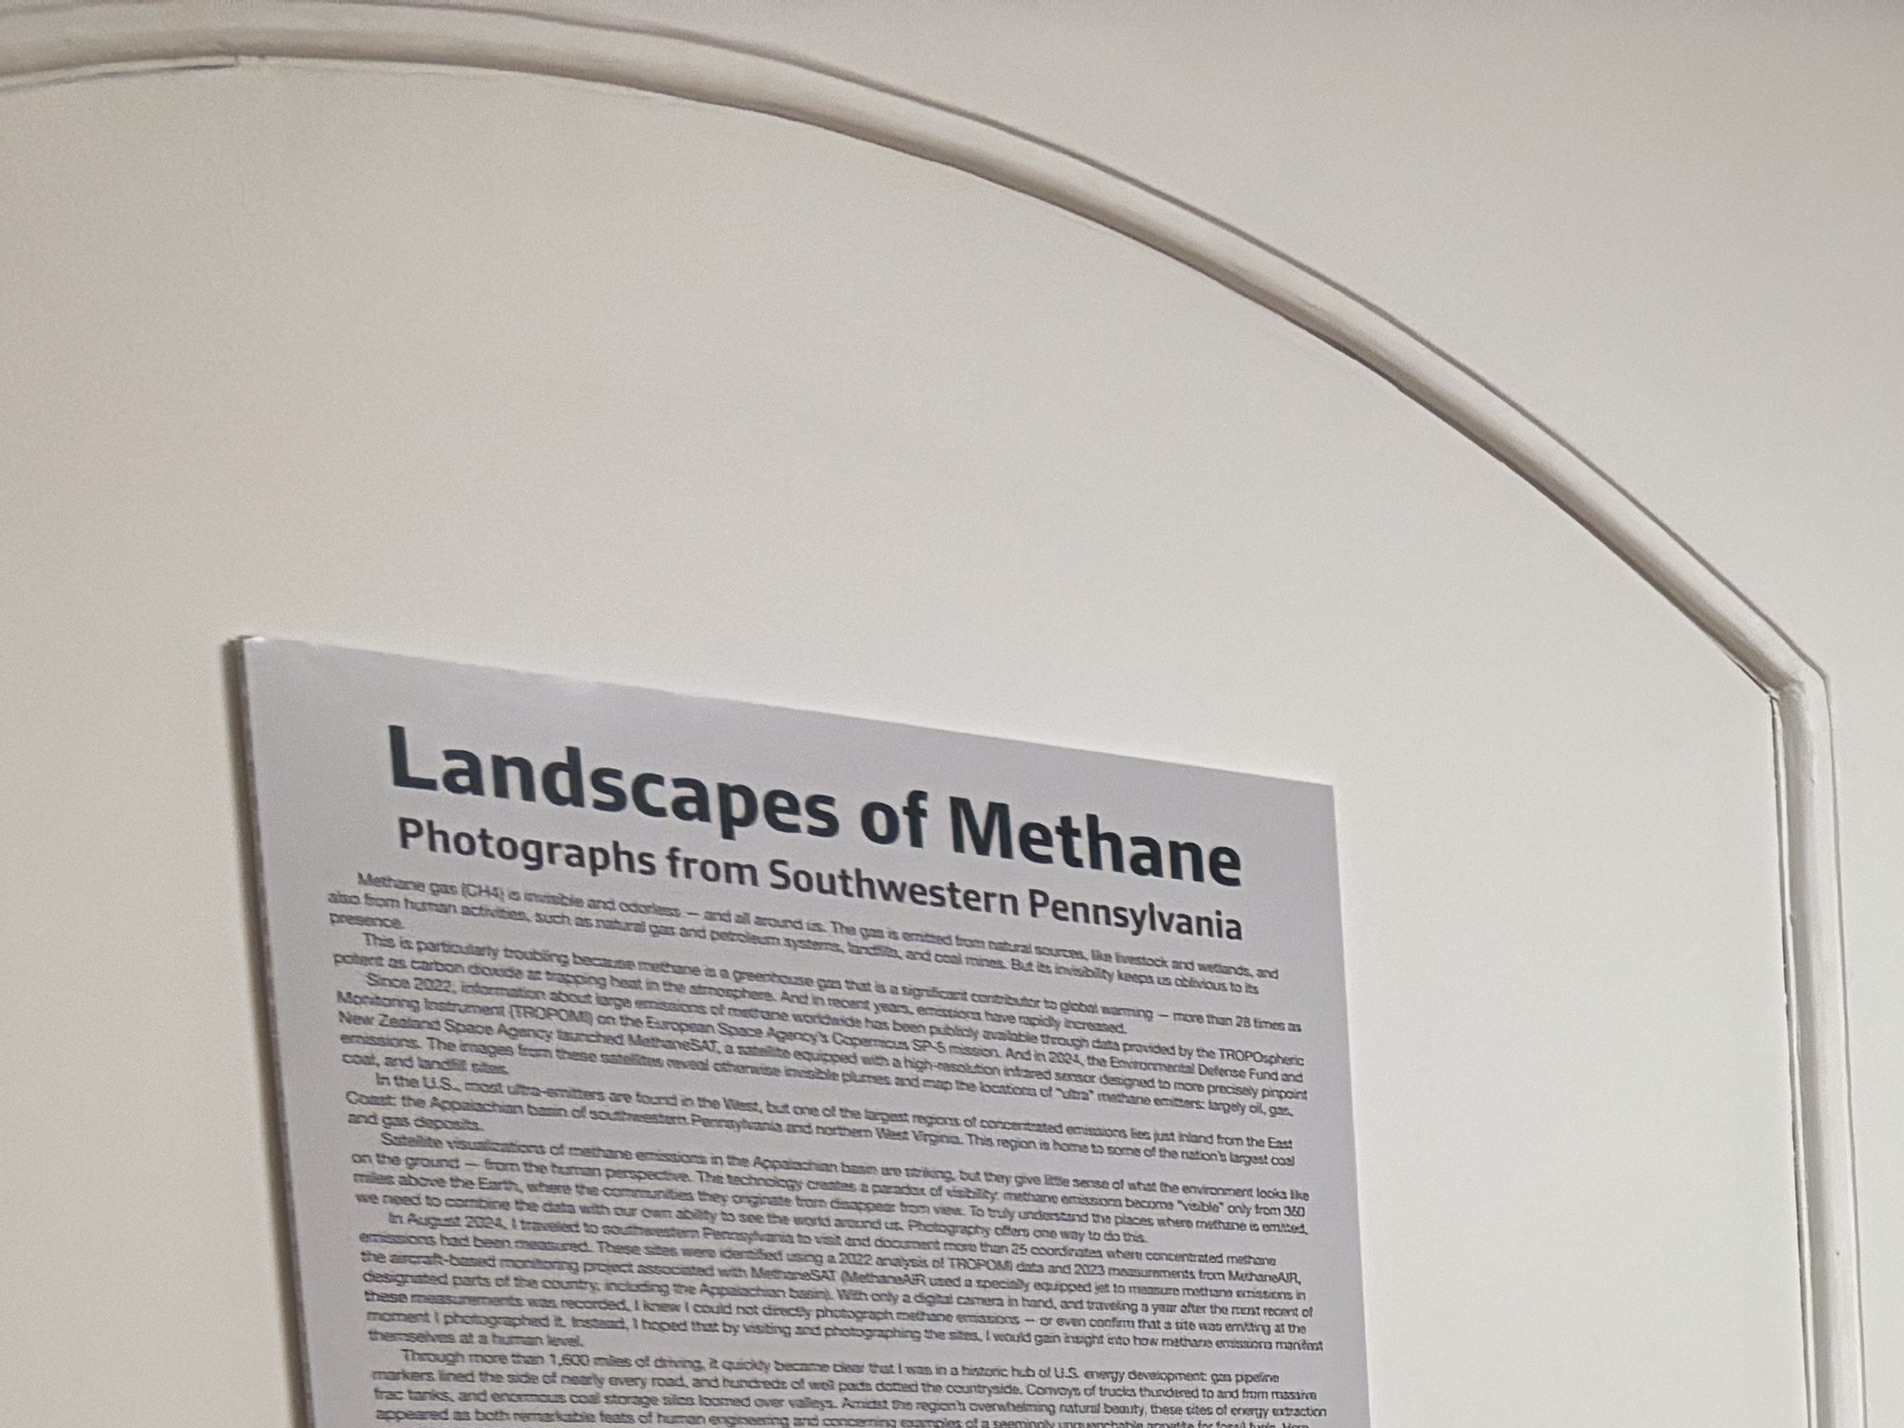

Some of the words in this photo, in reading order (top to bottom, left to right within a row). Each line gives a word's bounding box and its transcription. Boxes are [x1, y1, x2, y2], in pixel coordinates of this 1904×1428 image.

[388, 724, 839, 840] Landscapes
[860, 789, 927, 848] of
[949, 795, 1240, 886] Methane
[398, 816, 656, 876] Photographs
[665, 846, 758, 886] from
[768, 858, 1019, 915] Southwestern
[1028, 888, 1242, 940] Pennsylvania
